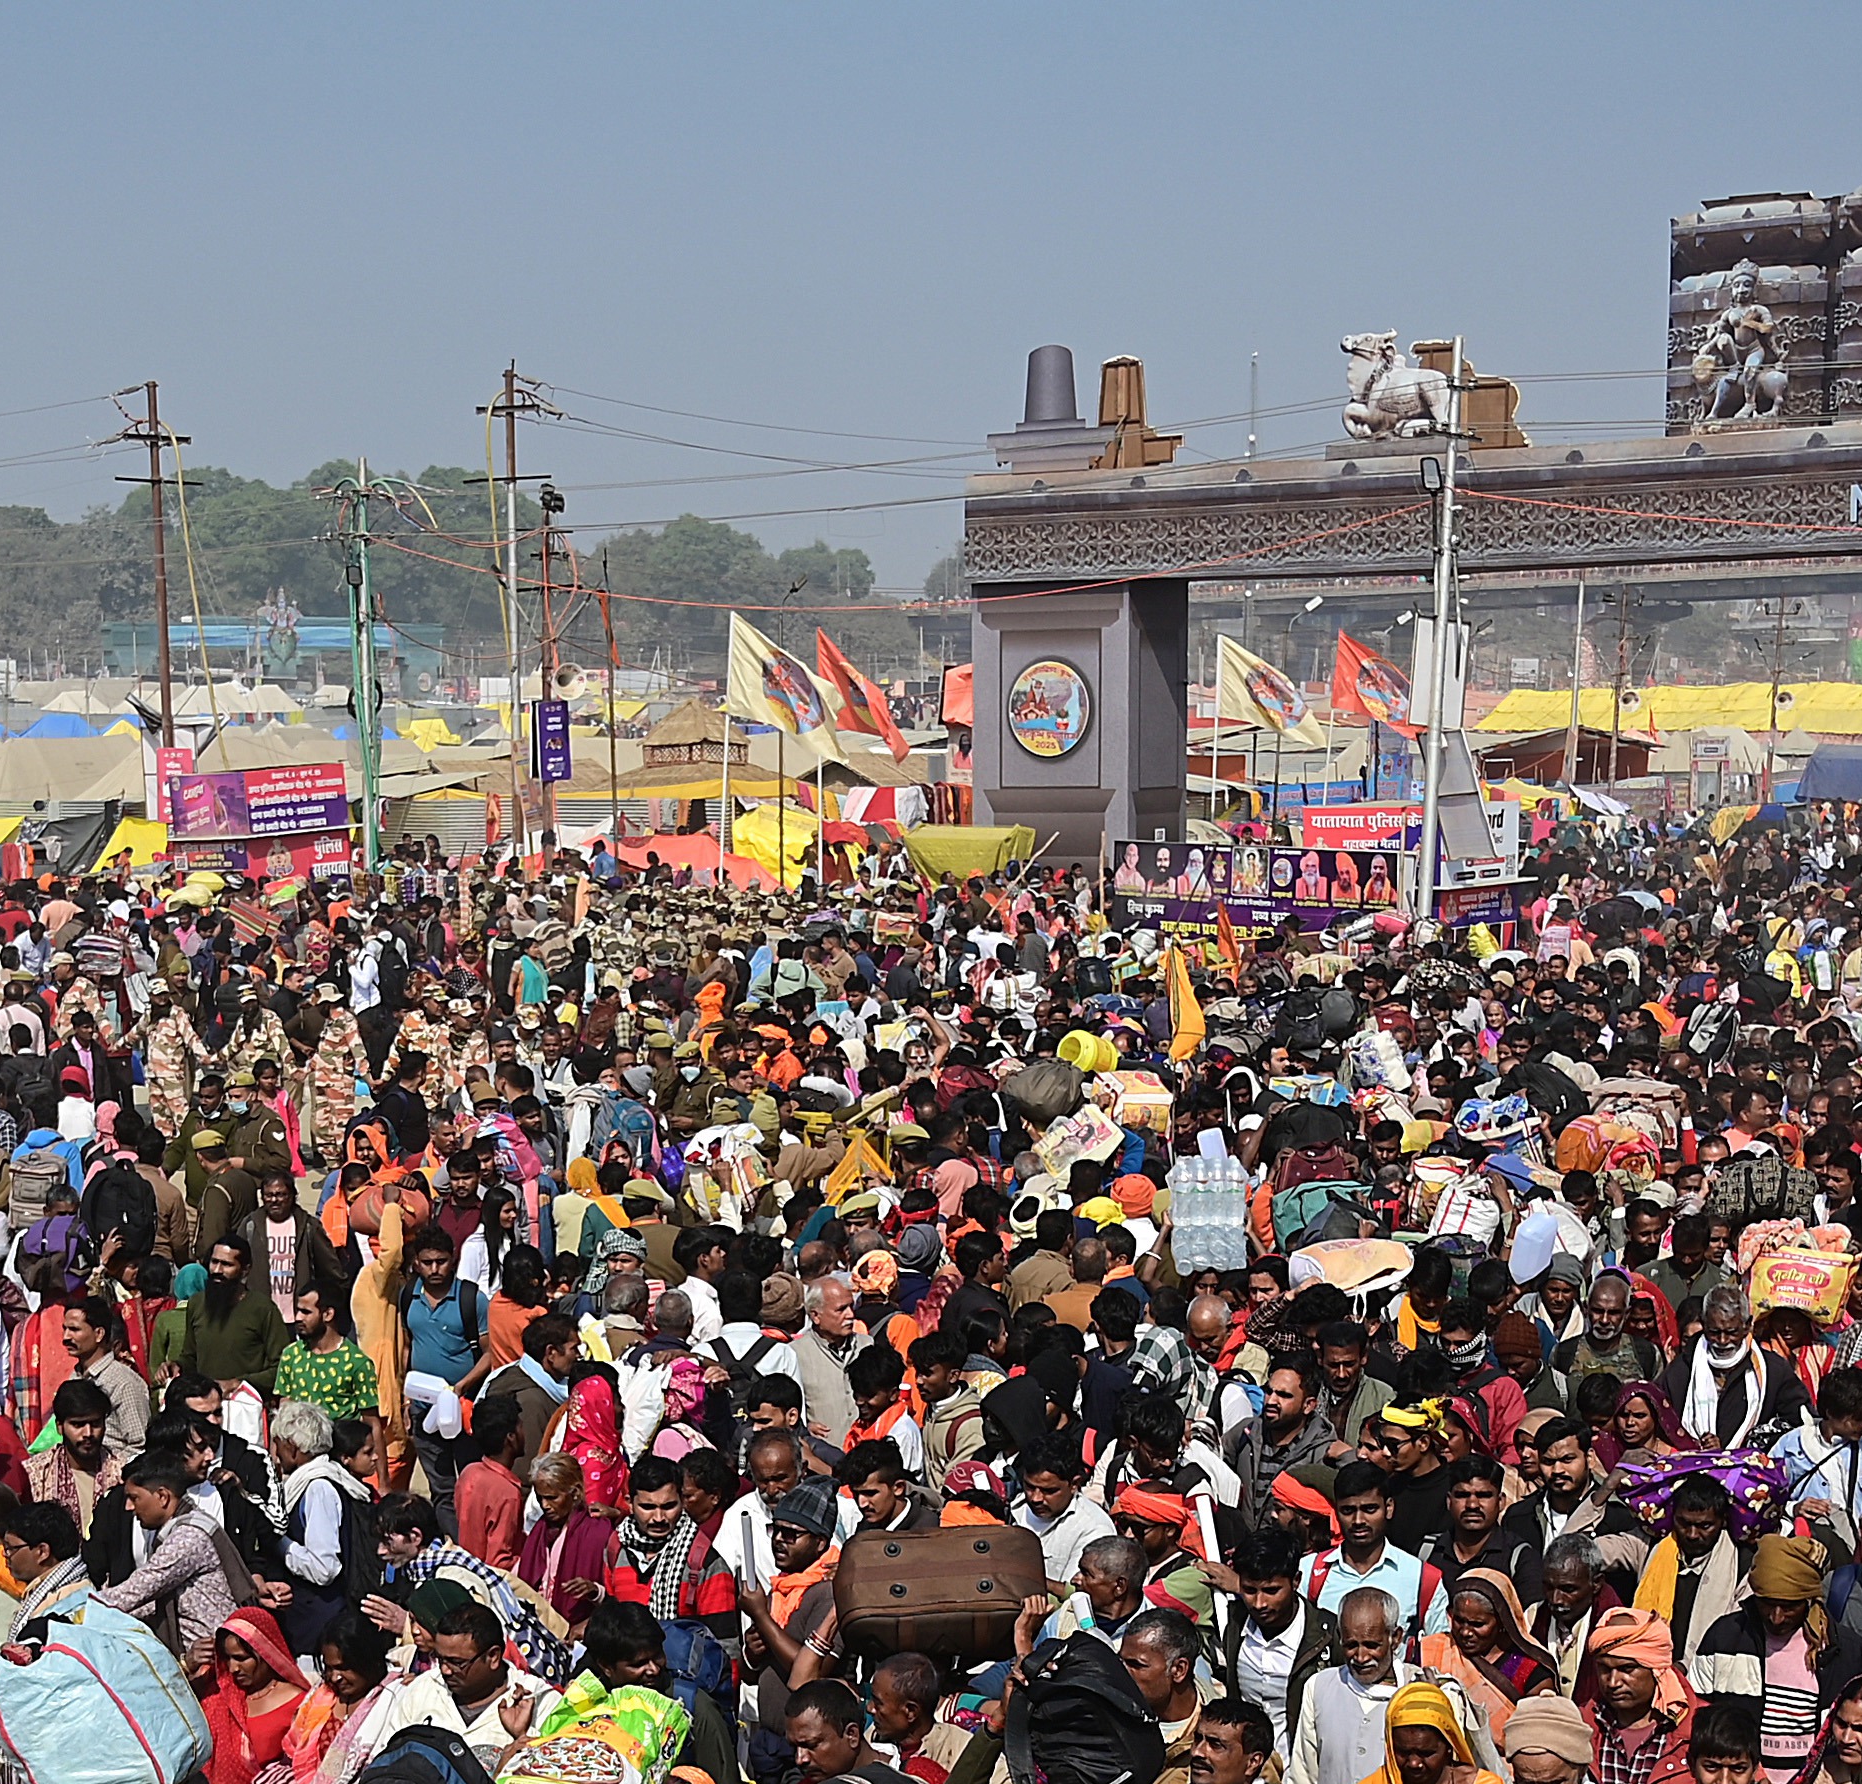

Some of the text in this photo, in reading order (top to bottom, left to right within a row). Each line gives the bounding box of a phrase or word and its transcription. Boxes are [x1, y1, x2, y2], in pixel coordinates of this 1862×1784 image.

[1035, 741, 1056, 749] 2025
[1311, 815, 1365, 828] यातायात
[1367, 813, 1403, 832] पुलिस
[314, 837, 343, 859] पुलिस
[312, 862, 349, 877] सहायता
[269, 1236, 297, 1254] OUR
